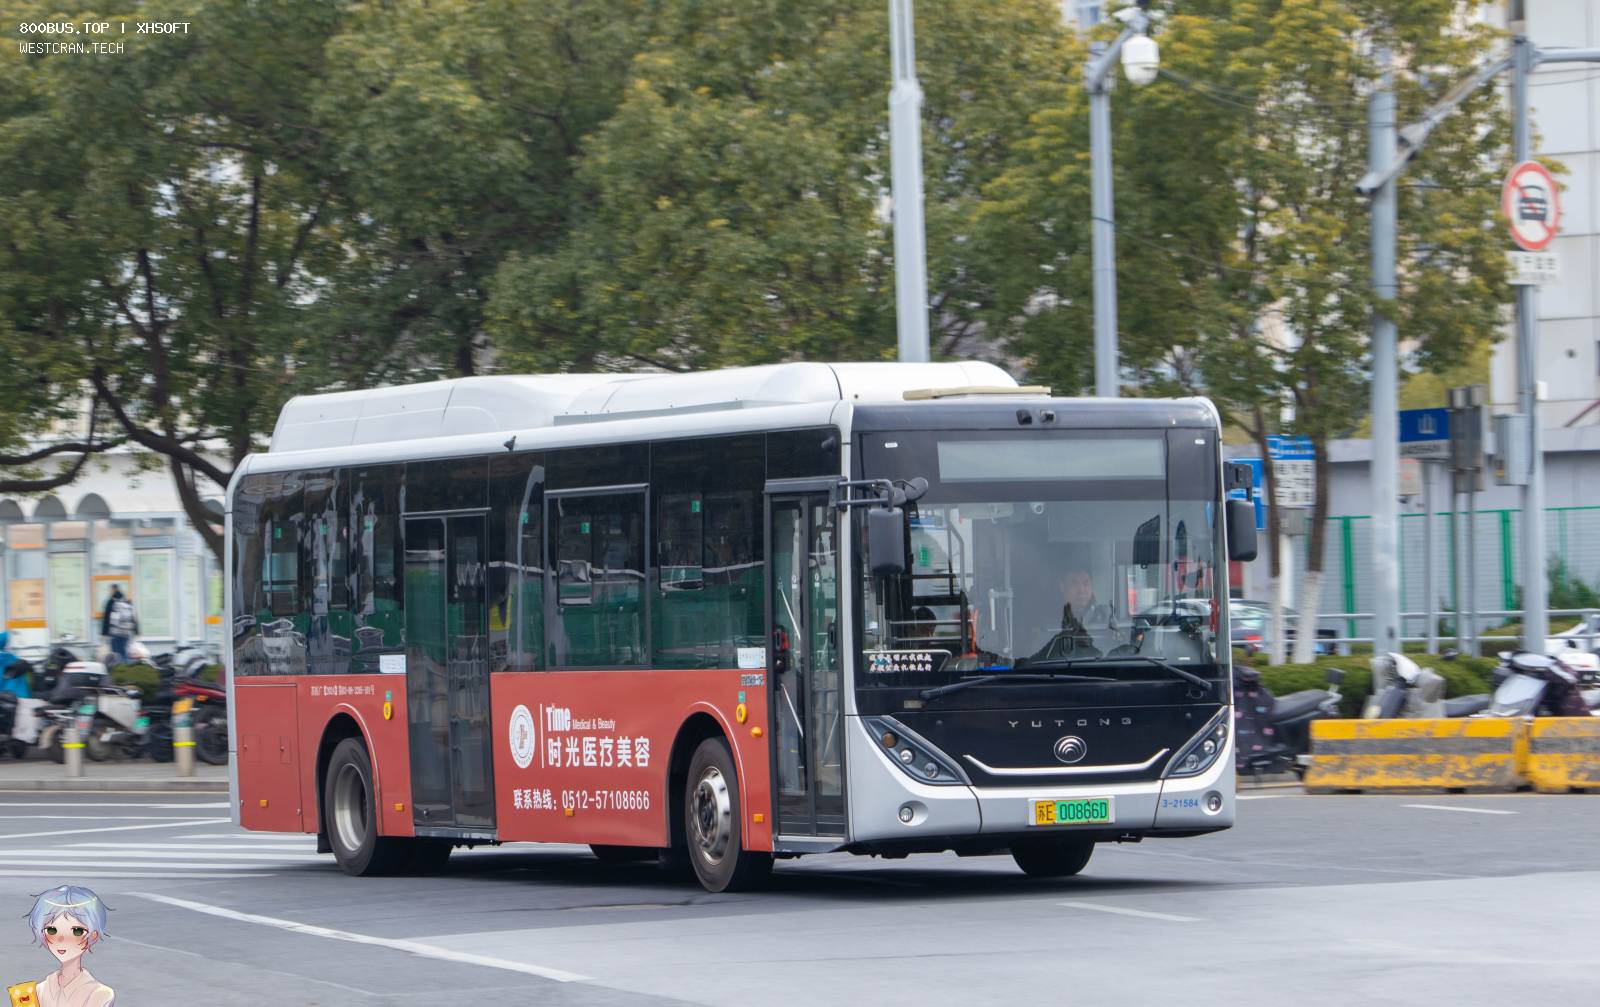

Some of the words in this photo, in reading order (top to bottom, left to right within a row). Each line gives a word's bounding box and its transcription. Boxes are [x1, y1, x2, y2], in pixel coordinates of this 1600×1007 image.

[545, 703, 571, 732] Time
[572, 719, 591, 730] Medical
[592, 719, 597, 730] &
[597, 718, 616, 732] Beauty
[1008, 717, 1132, 728] YUTONG
[547, 735, 650, 768] 时光医疗美容
[1162, 799, 1199, 809] 3-21584
